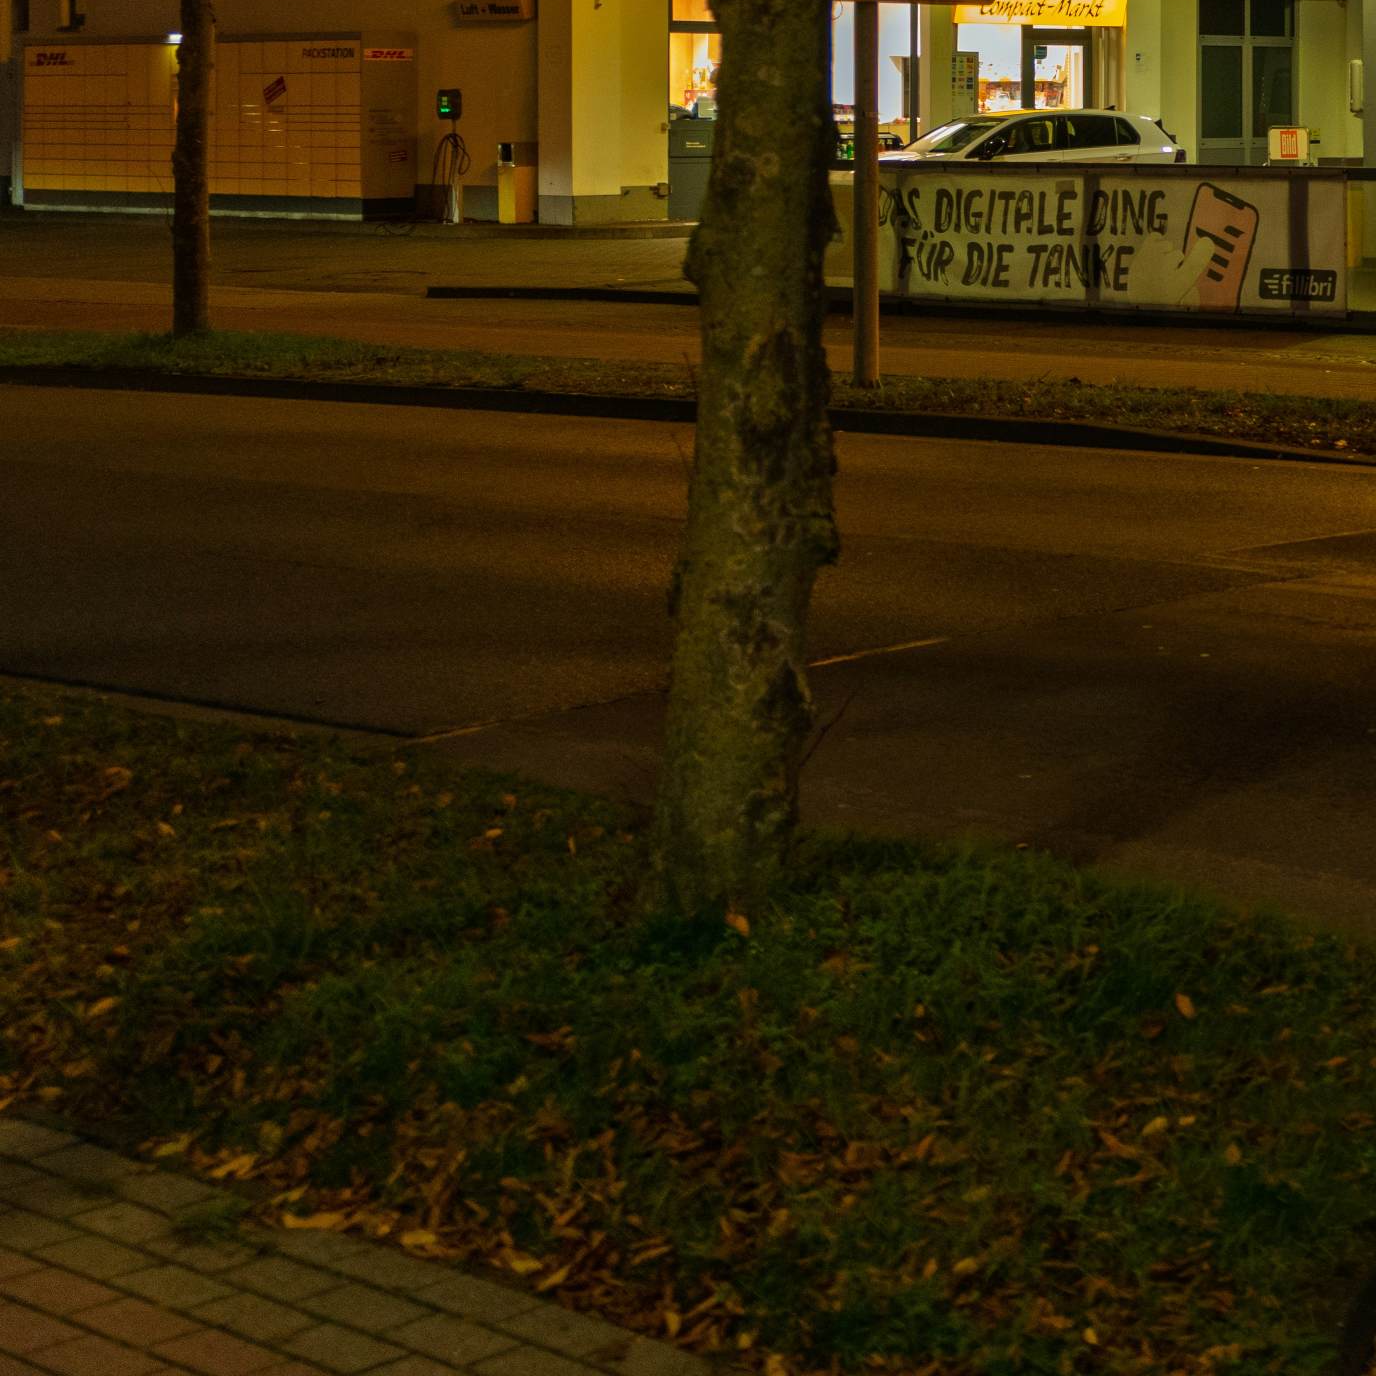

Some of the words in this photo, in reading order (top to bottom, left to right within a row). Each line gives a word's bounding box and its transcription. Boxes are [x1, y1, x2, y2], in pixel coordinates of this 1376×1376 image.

[36, 52, 68, 66] DHL
[302, 47, 355, 59] PACKSTATION
[371, 50, 407, 59] DHL
[1281, 133, 1297, 155] Bild
[879, 185, 922, 231] DAS
[934, 188, 1078, 236] DIGITALE
[1086, 189, 1168, 236] DING
[898, 230, 955, 287] FÜR
[962, 242, 1014, 288] DIE
[1027, 244, 1135, 291] TANKE
